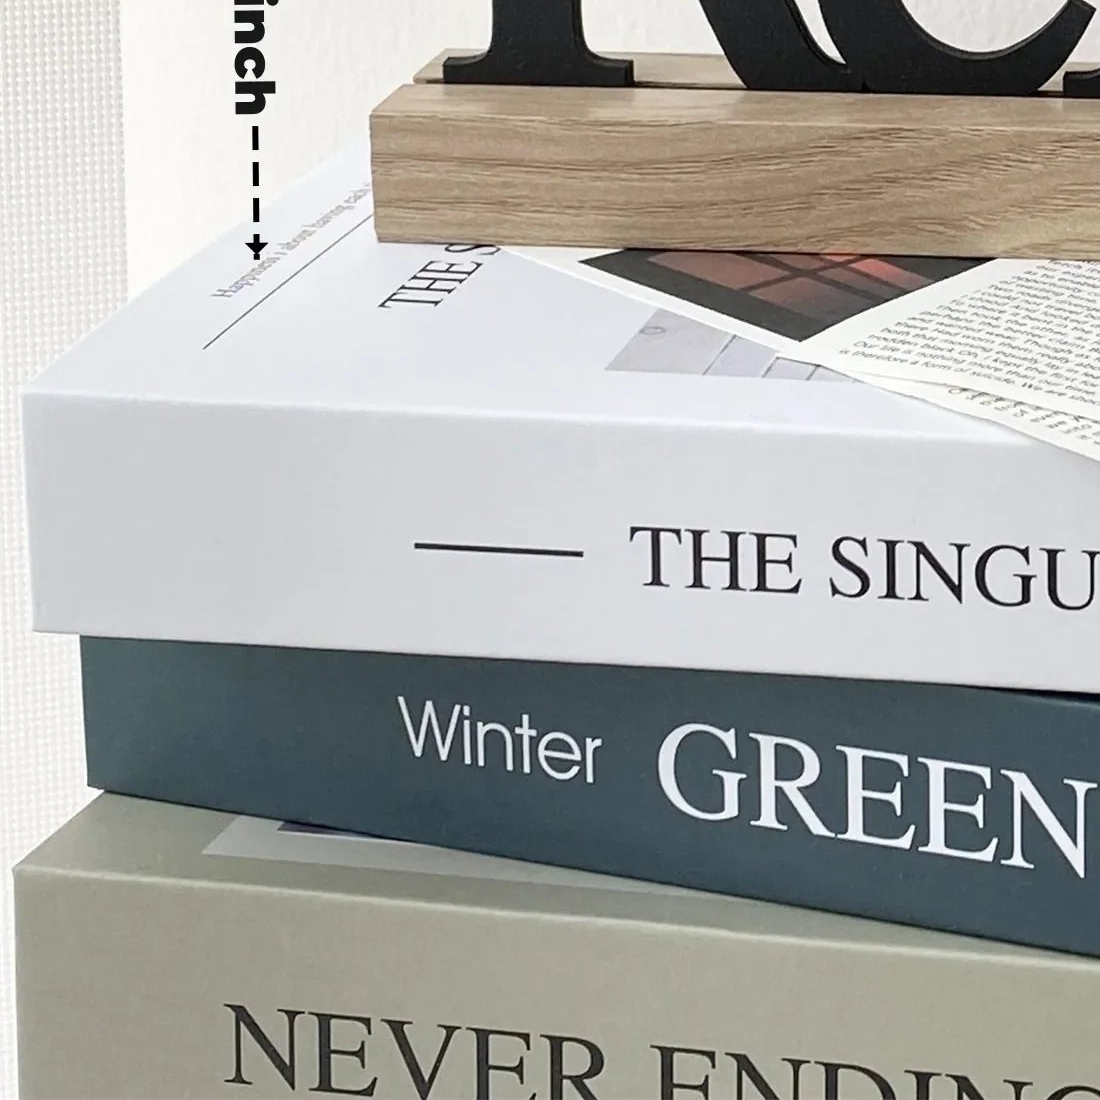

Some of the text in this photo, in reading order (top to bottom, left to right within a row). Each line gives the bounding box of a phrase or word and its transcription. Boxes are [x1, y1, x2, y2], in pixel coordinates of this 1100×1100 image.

[379, 261, 482, 307] THE
[630, 527, 801, 594] THE
[398, 696, 601, 783] Winter
[224, 1004, 604, 1100] NEVER
